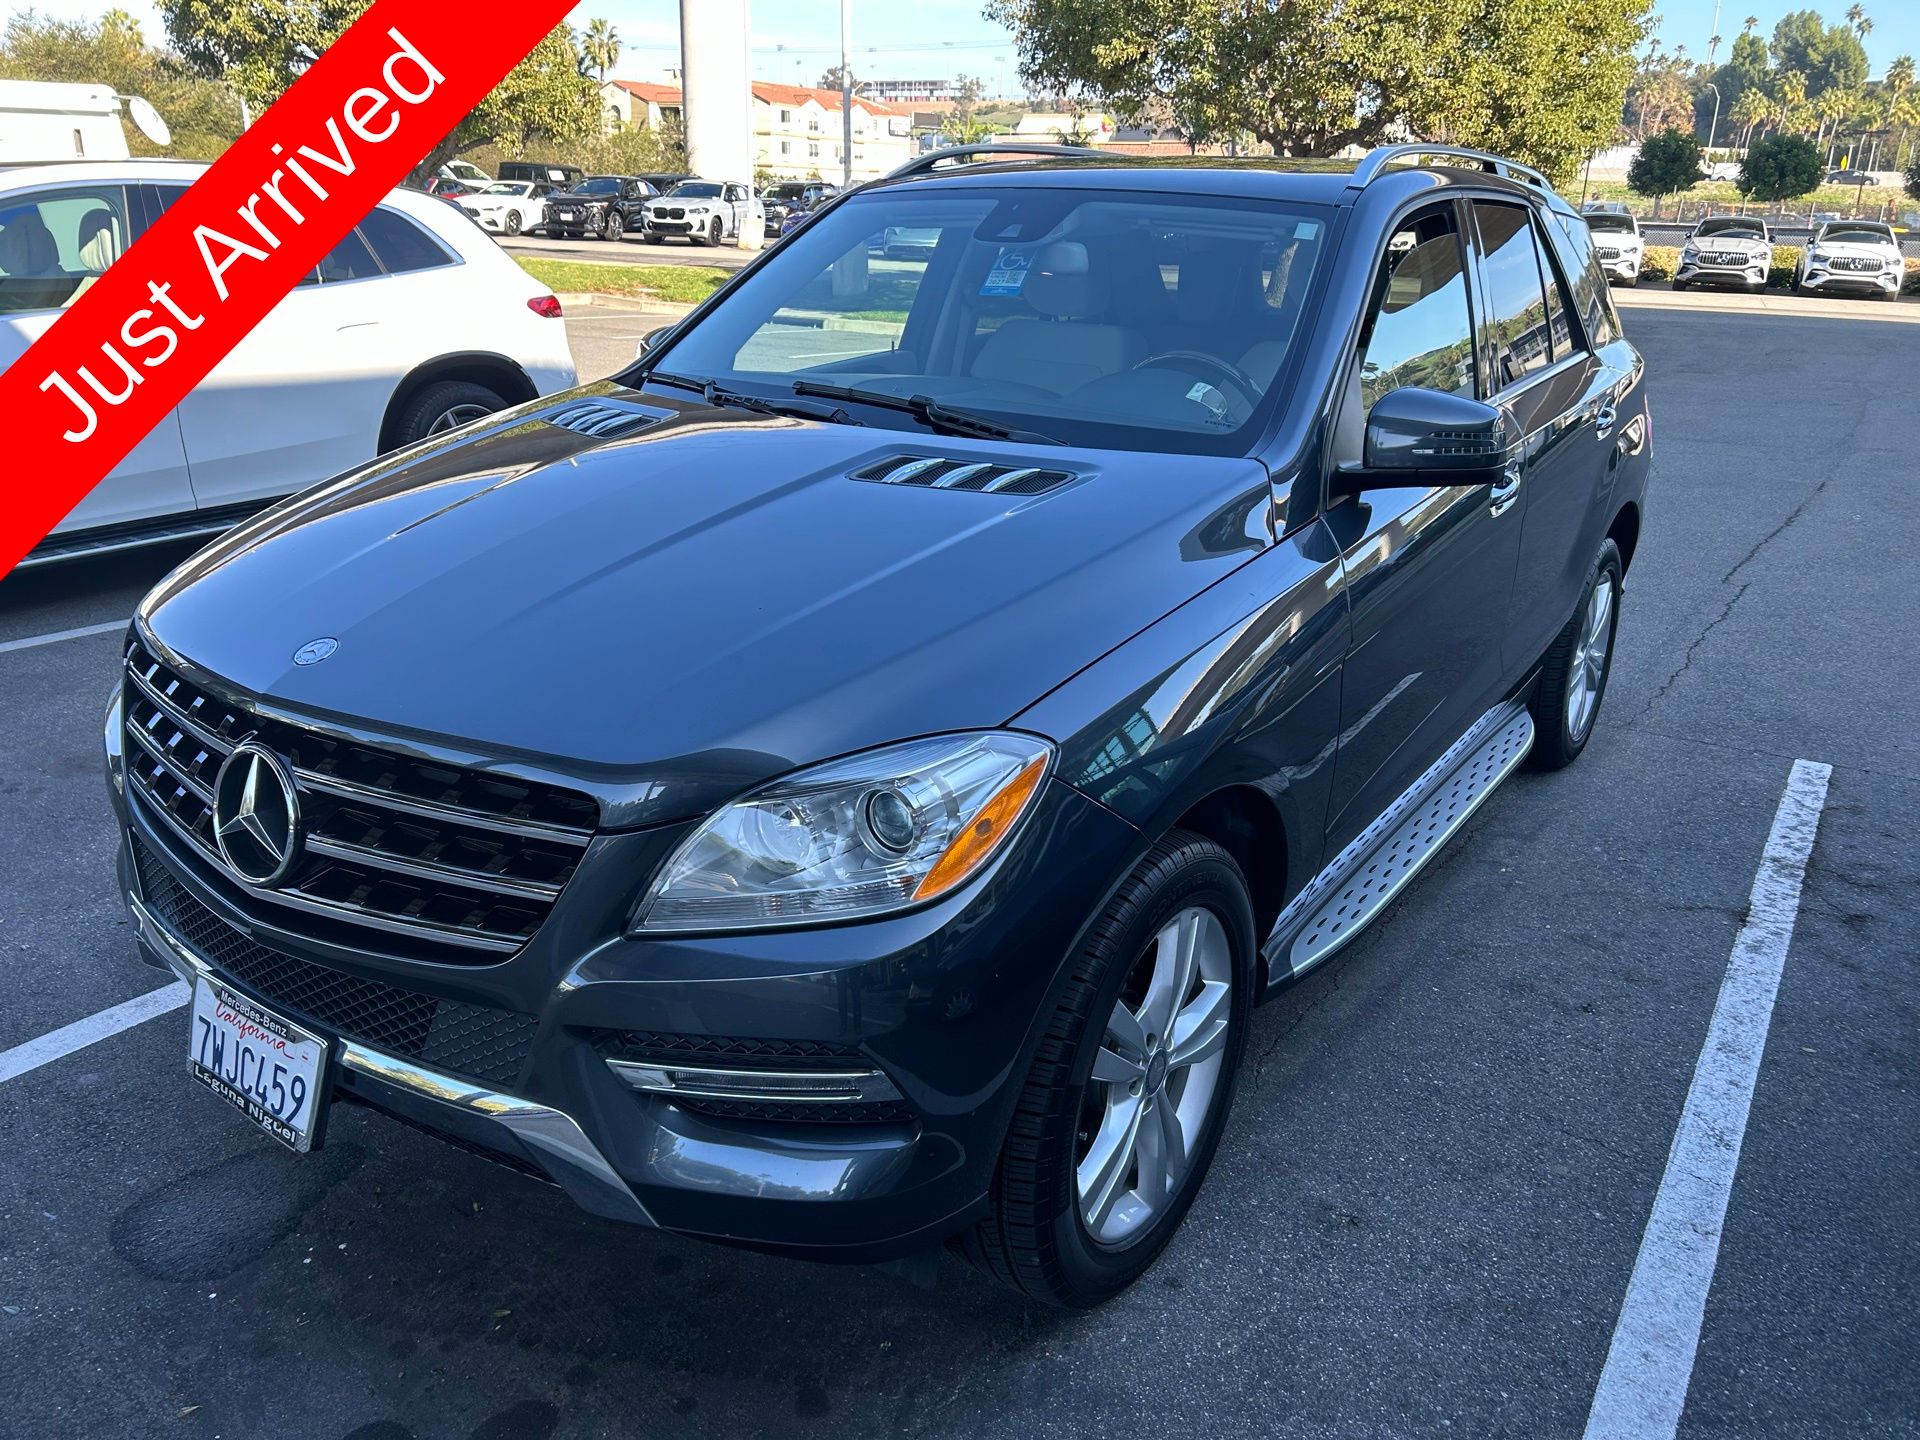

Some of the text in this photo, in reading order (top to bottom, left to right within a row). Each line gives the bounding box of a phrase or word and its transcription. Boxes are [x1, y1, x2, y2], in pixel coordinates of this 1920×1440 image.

[216, 1002, 295, 1060] California
[220, 989, 288, 1038] Mercedes-Benz
[198, 1014, 306, 1124] 7WJC459
[194, 1065, 296, 1143] Laguna Niguel
